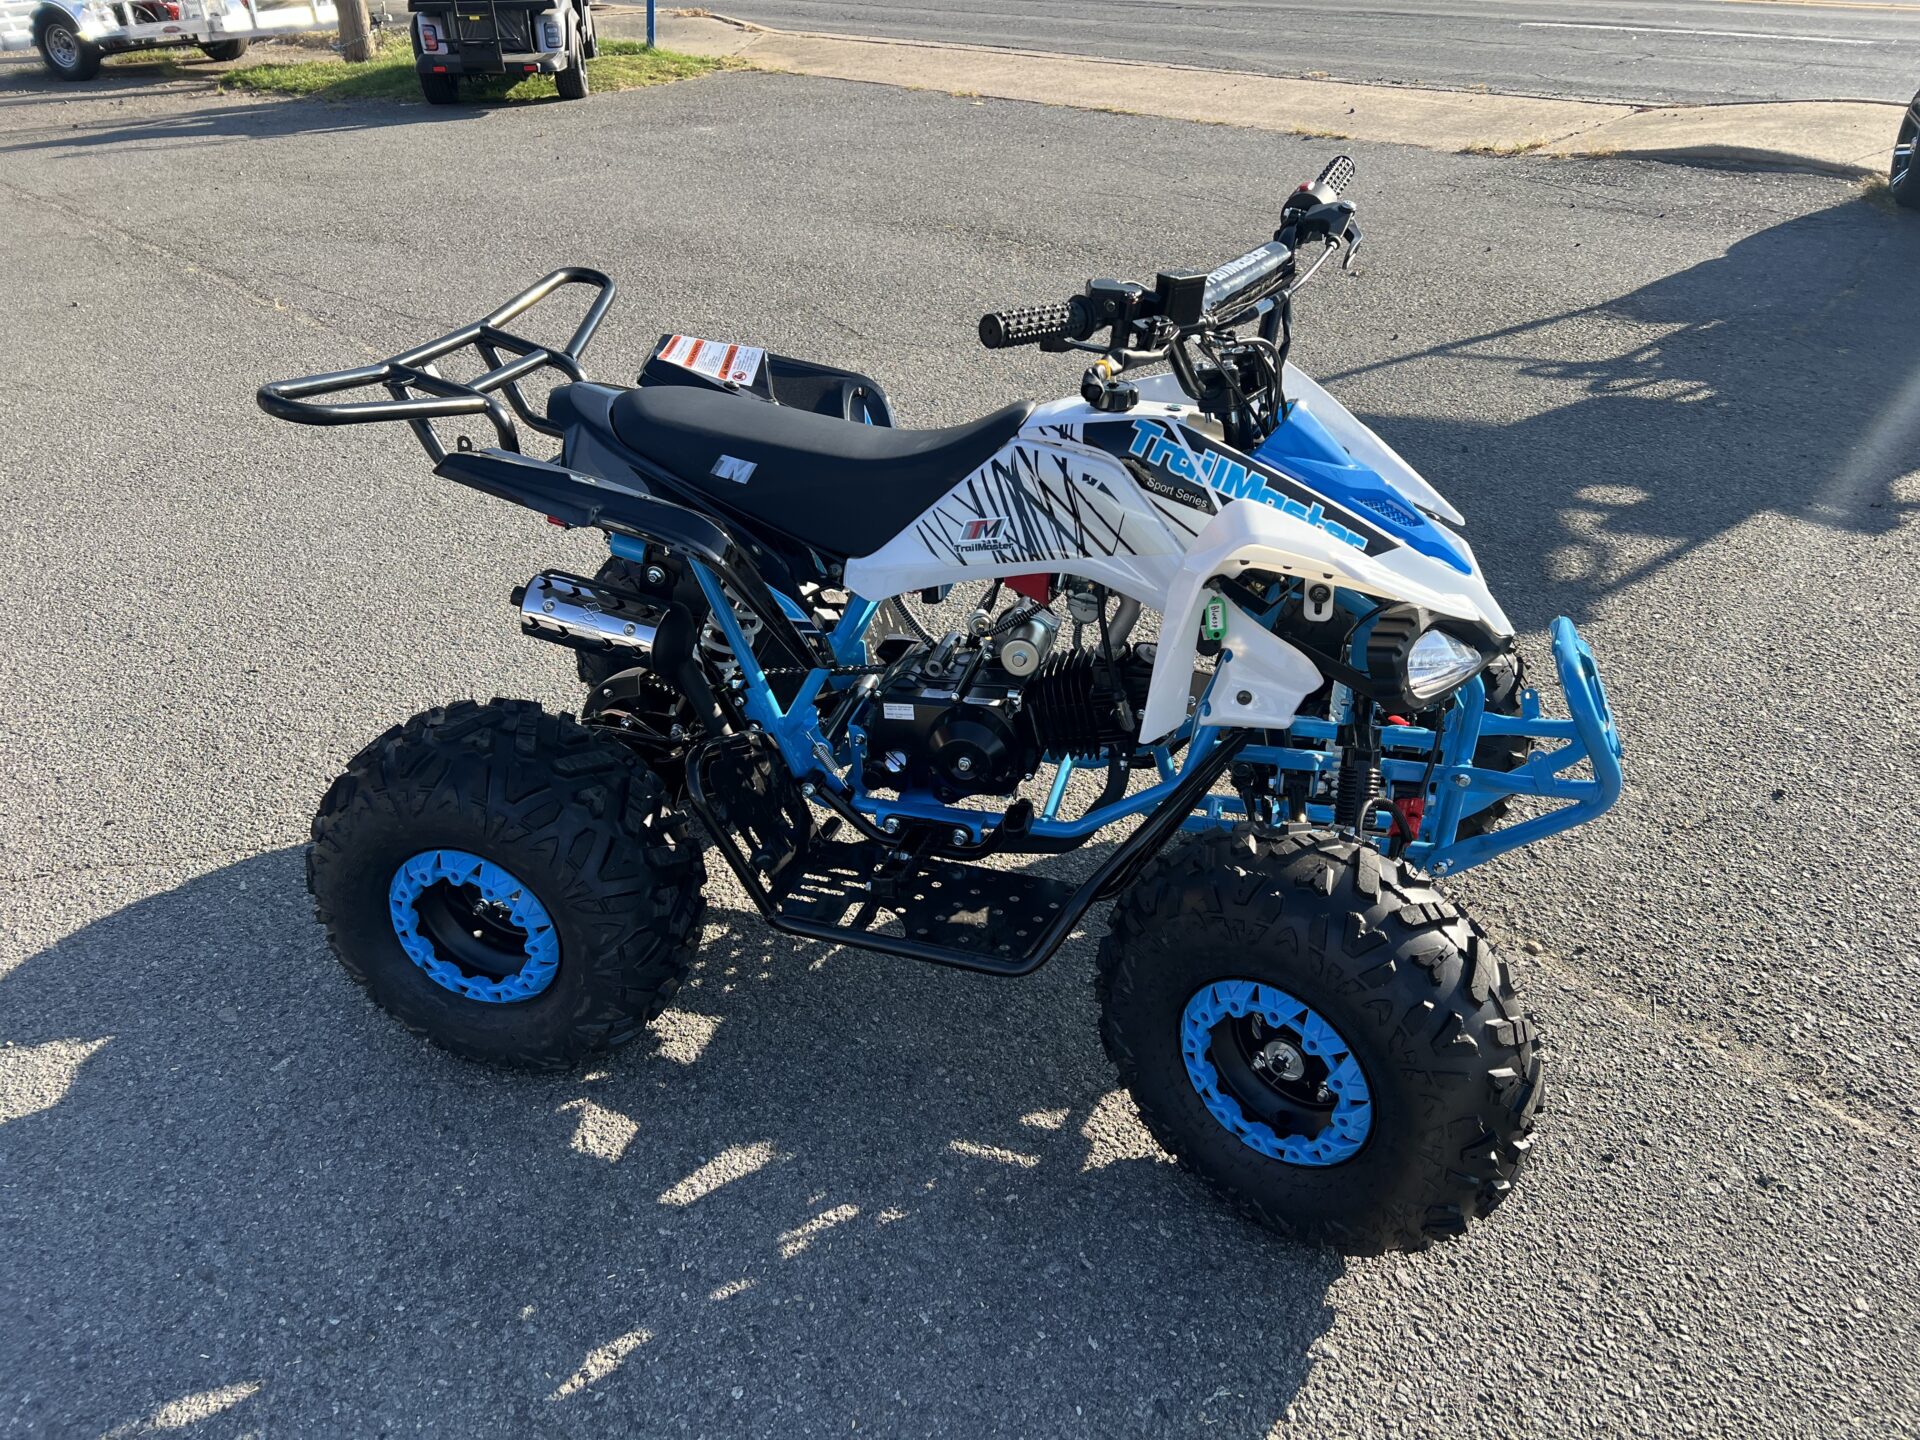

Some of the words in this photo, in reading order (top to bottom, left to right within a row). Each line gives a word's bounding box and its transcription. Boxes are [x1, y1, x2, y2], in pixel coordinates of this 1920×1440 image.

[1146, 477, 1174, 496] Sport
[1175, 487, 1208, 509] Series
[954, 541, 1013, 553] TrailMaster
